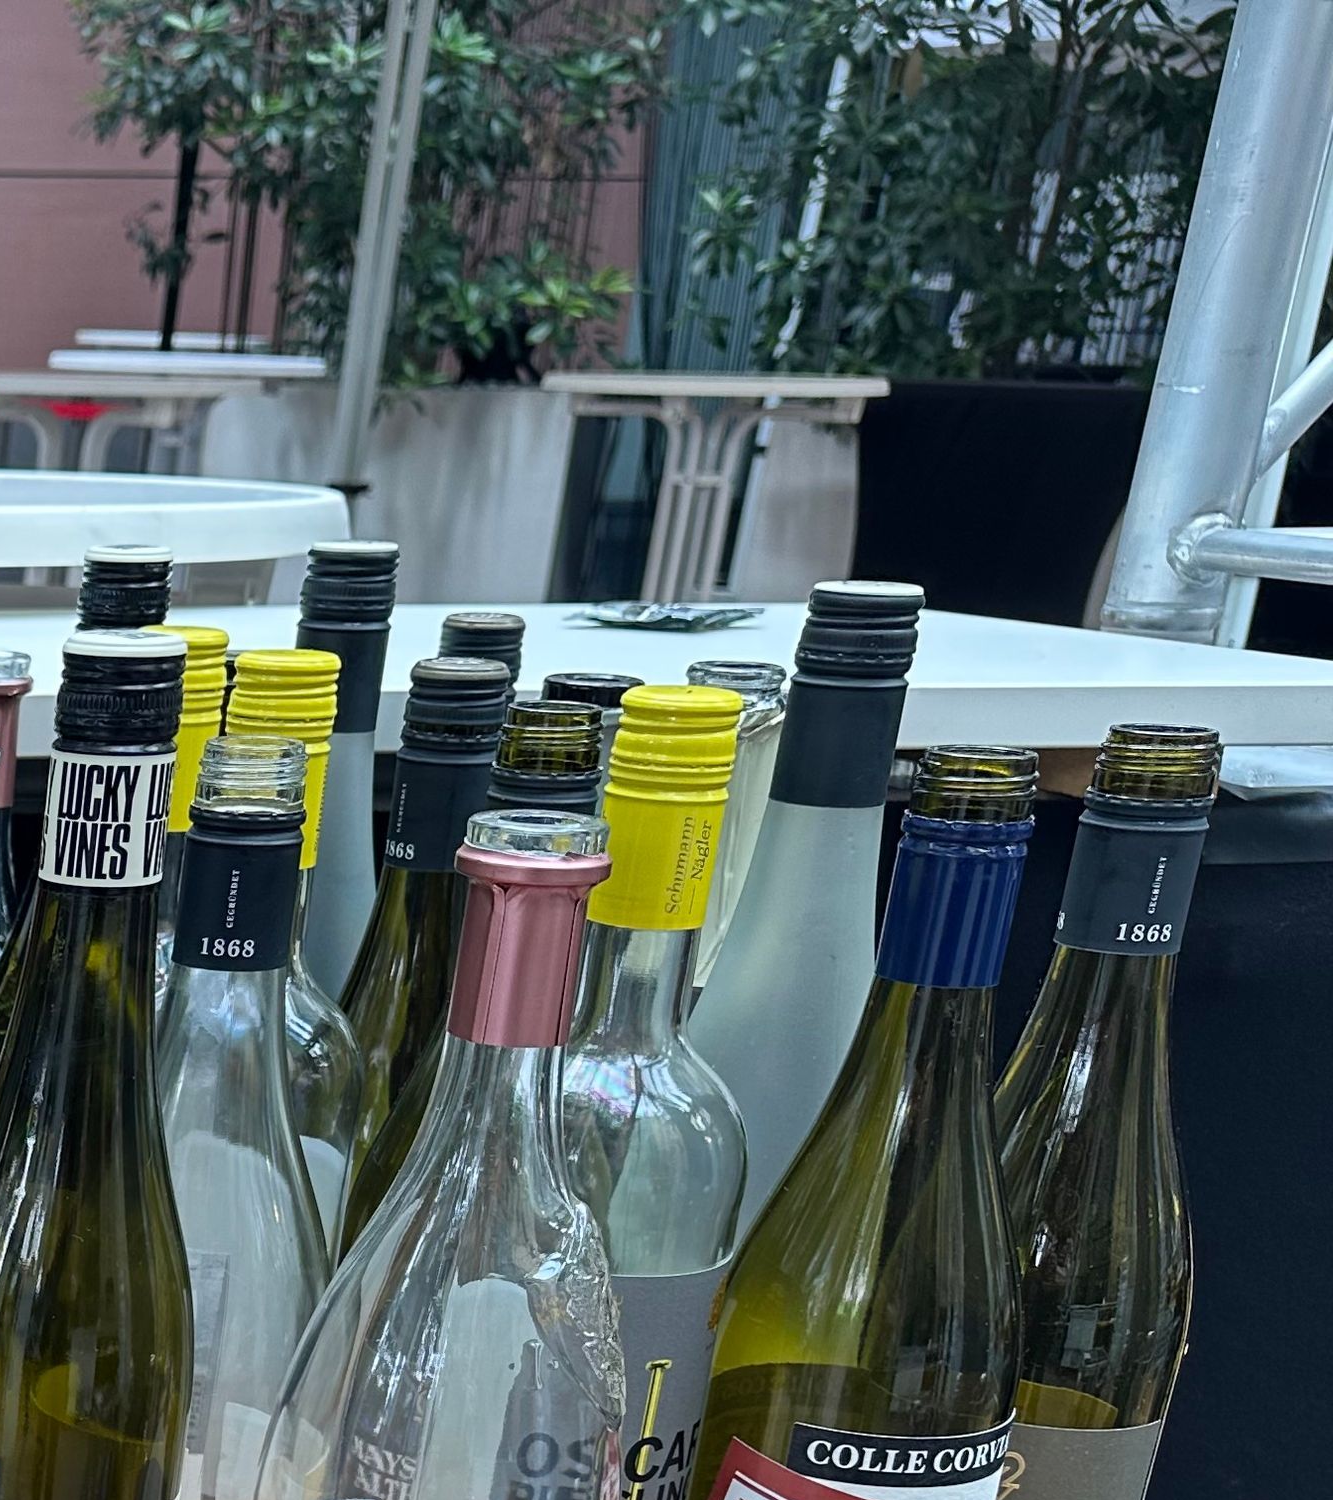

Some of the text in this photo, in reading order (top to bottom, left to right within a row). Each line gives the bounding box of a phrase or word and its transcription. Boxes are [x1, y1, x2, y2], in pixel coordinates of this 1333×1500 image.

[59, 761, 141, 821] LUCKY
[54, 823, 131, 880] VINES
[664, 815, 695, 915] Schumann
[691, 819, 713, 881] Nägler
[200, 936, 256, 958] 1868
[1115, 923, 1173, 943] 1868
[805, 1439, 928, 1476] COLLE
